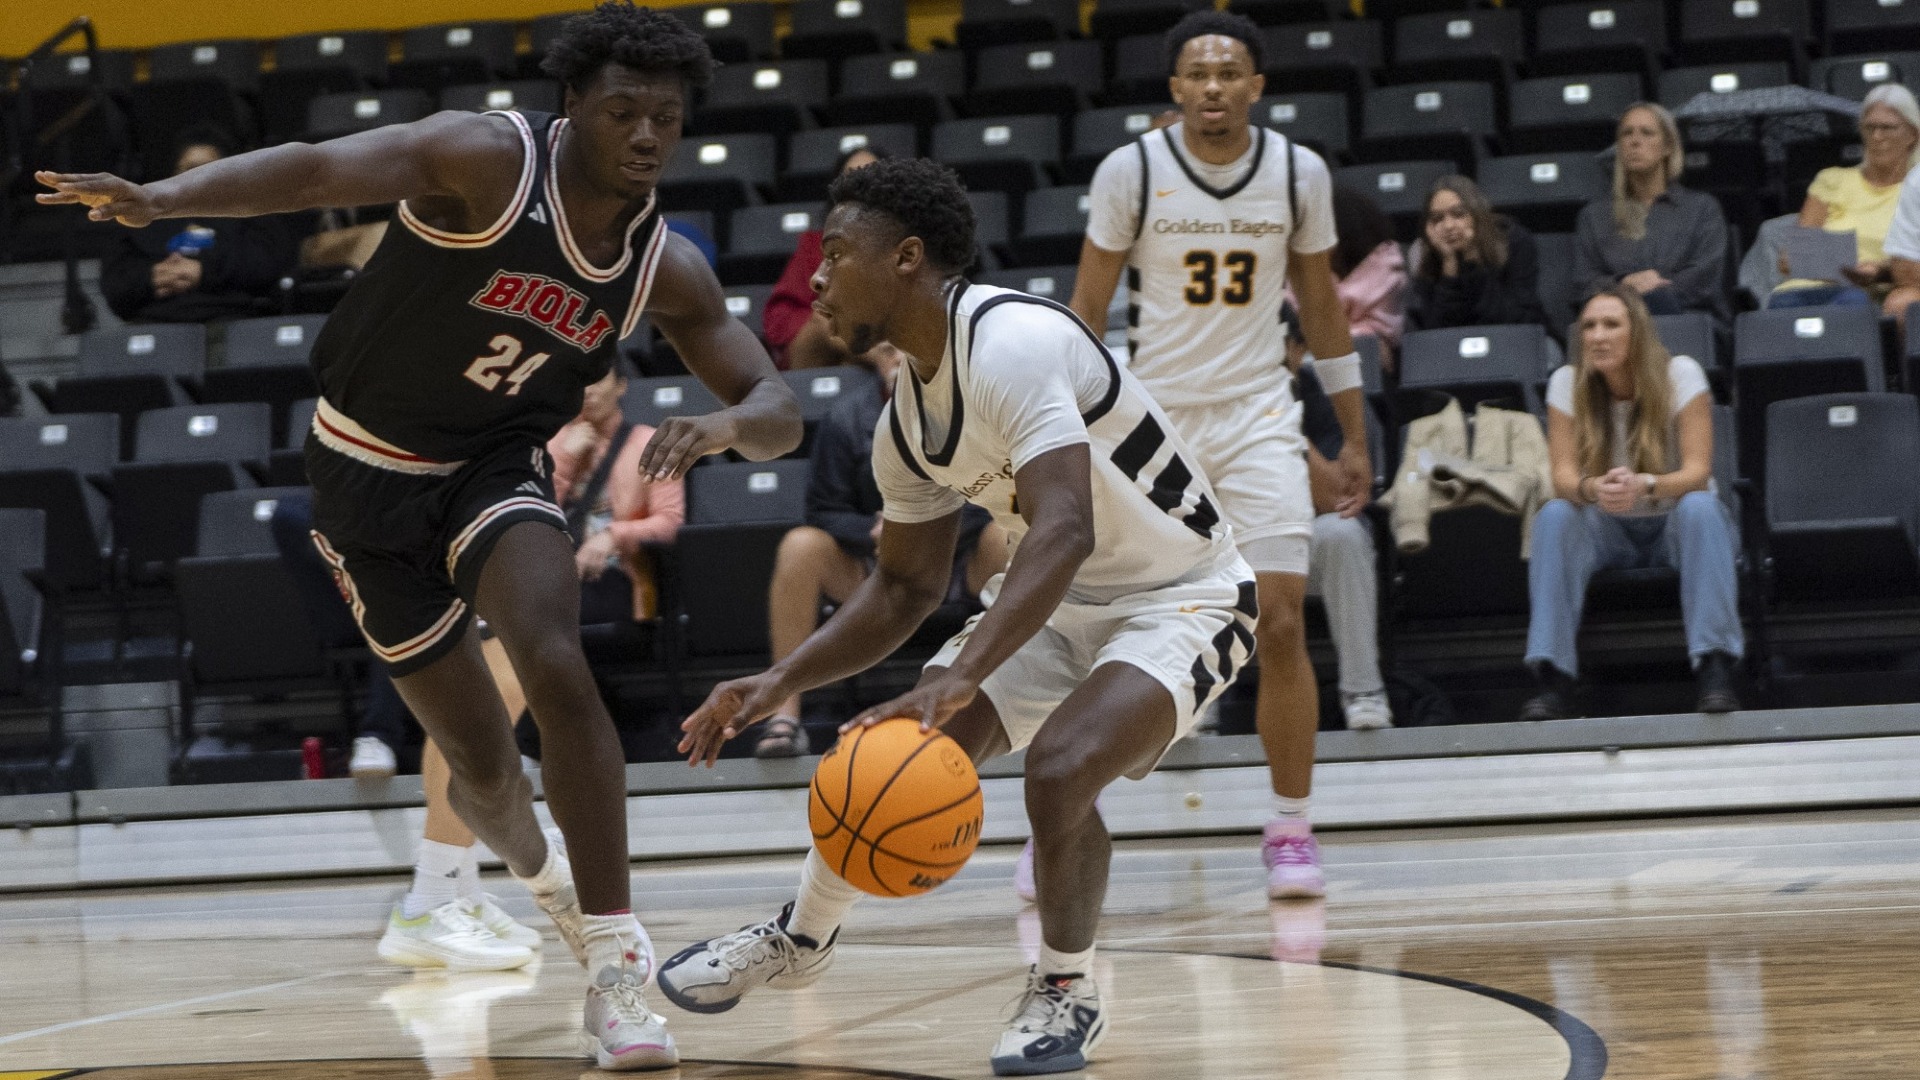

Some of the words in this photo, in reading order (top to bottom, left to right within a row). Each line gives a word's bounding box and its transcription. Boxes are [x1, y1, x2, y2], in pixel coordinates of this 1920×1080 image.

[1153, 218, 1225, 234] Golden
[1229, 218, 1285, 237] Eagles
[1183, 250, 1258, 307] 33
[469, 269, 615, 353] BIOLA
[463, 334, 553, 396] 24
